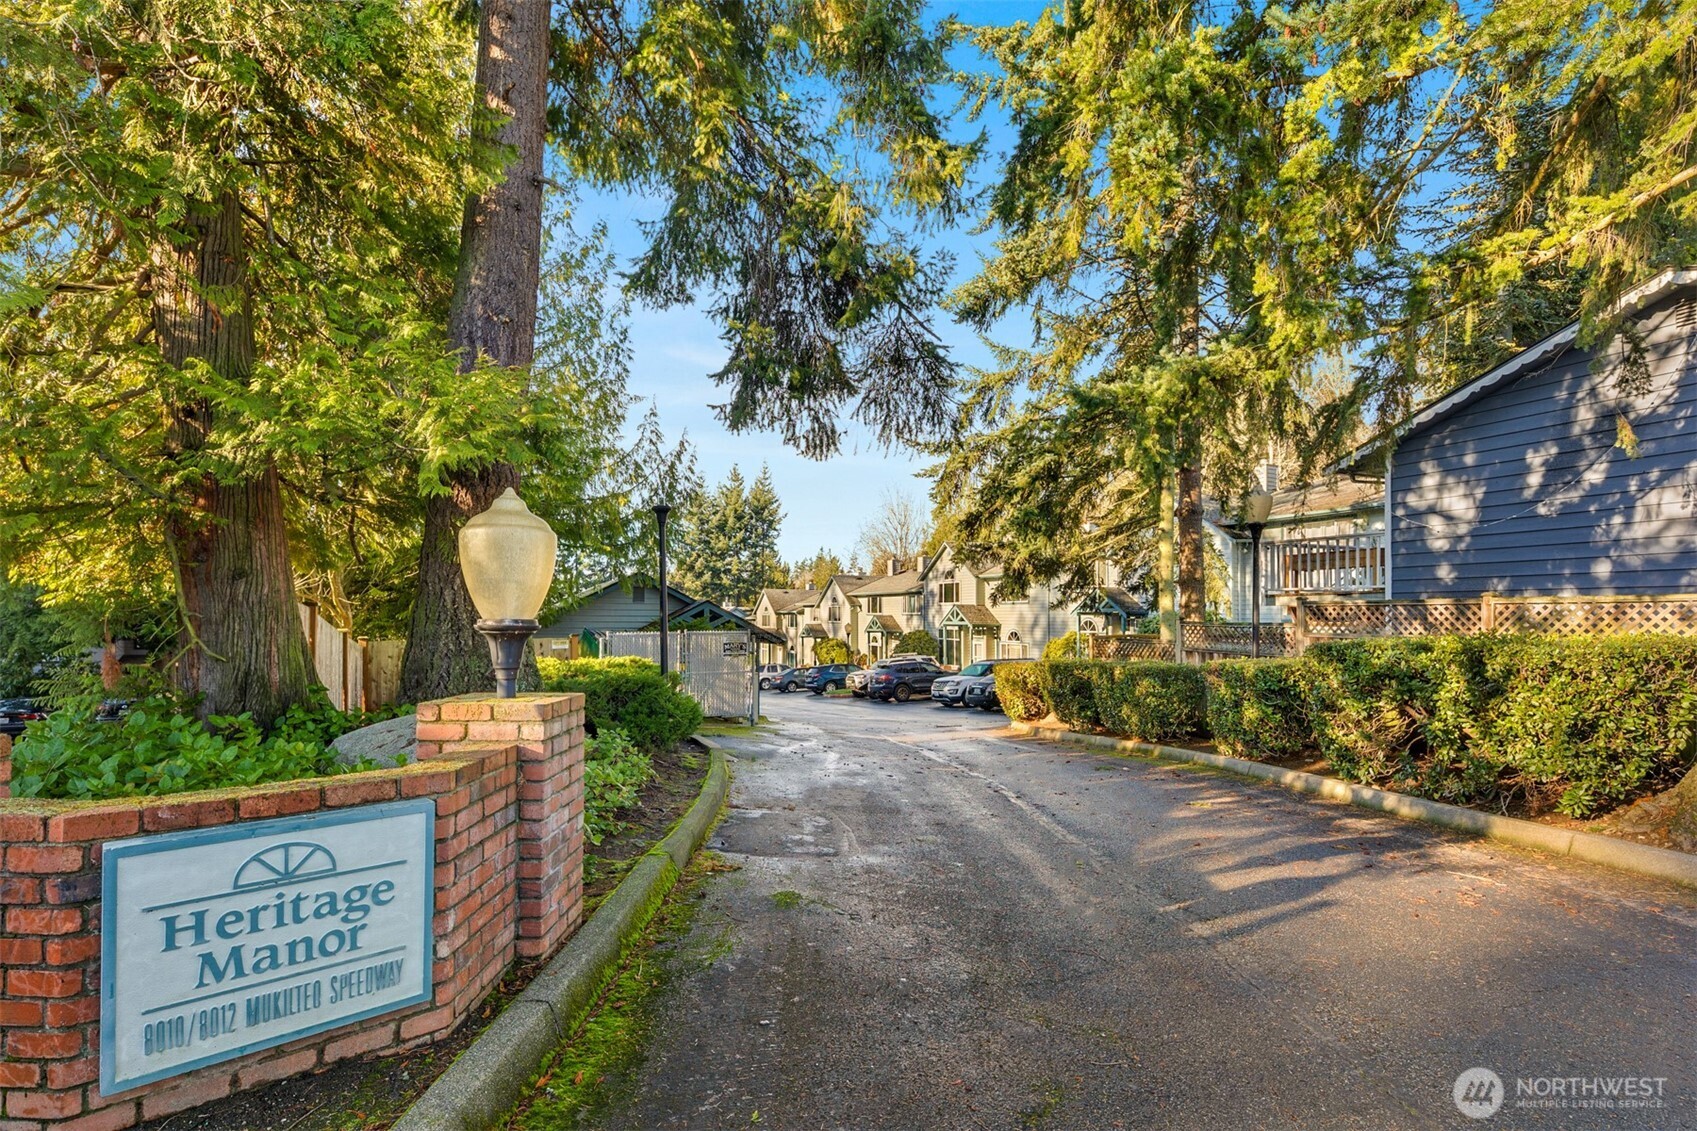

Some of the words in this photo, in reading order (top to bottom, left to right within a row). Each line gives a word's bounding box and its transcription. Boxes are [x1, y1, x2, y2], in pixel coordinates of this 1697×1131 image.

[159, 879, 396, 953] Heritage
[192, 922, 368, 990] Manor
[143, 1003, 236, 1056] 8010/8012
[245, 979, 322, 1027] MUKILTEO
[329, 957, 405, 1002] SPEEDWAY
